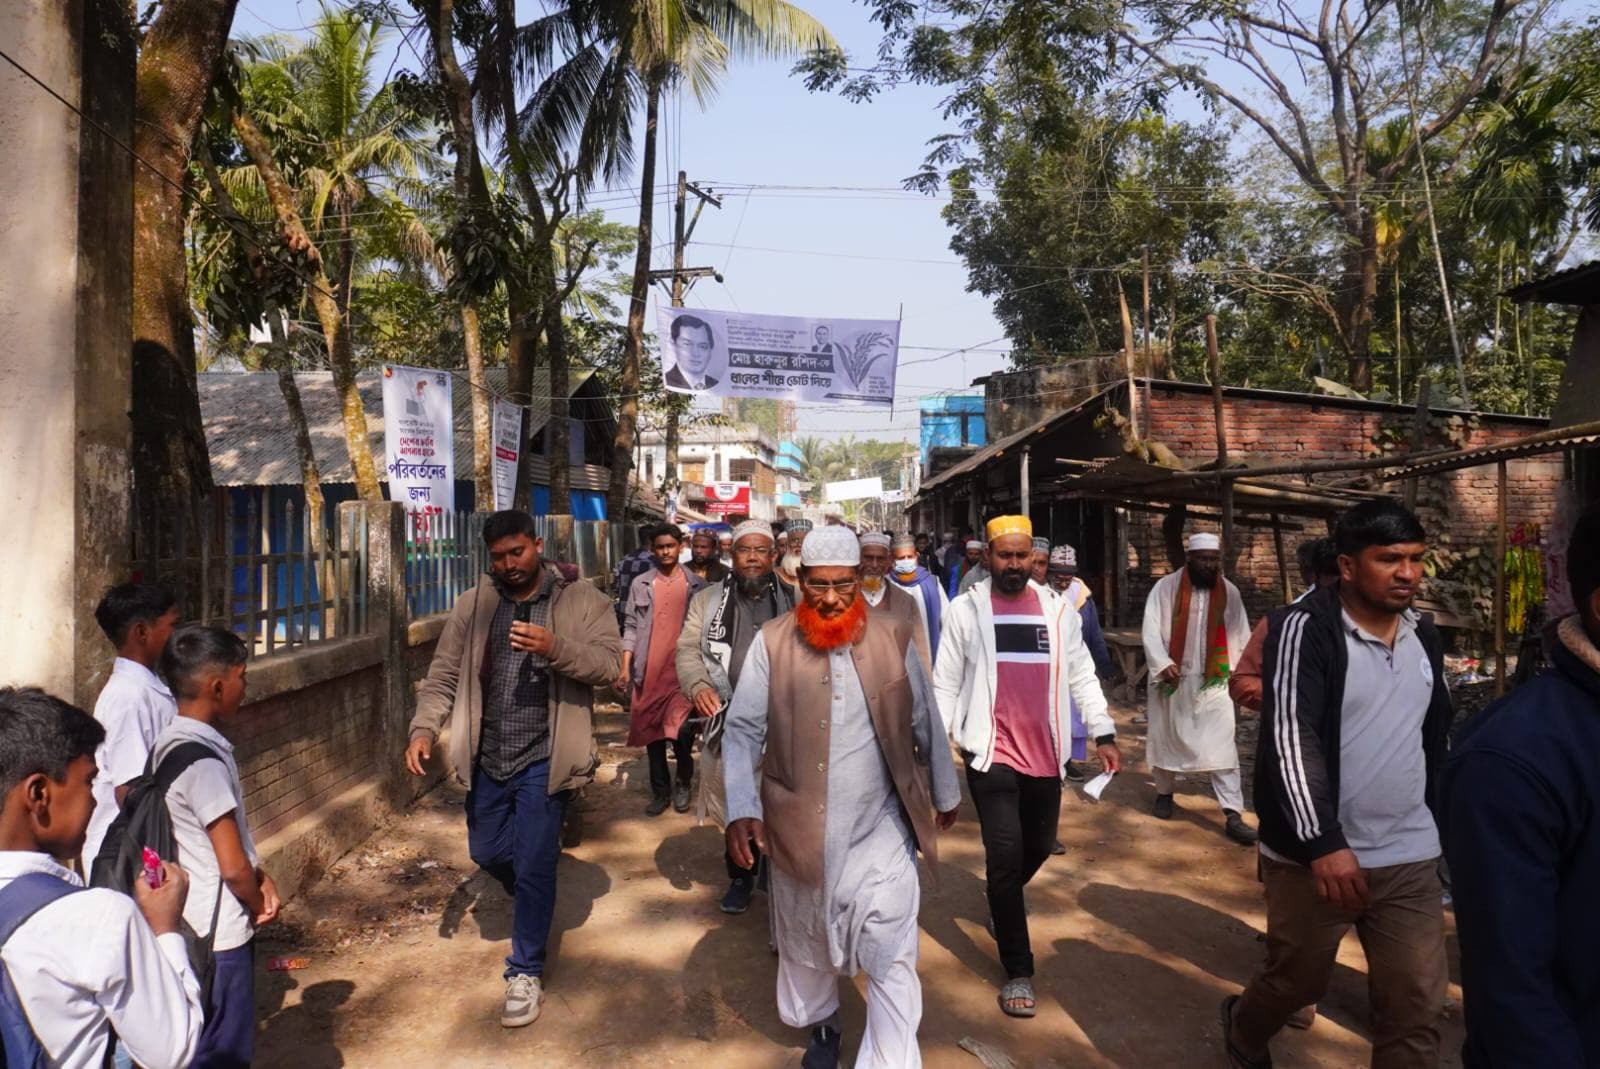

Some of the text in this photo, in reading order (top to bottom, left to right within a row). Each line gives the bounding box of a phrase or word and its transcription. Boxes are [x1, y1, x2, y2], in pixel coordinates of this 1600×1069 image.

[731, 352, 751, 365] মোঃ
[730, 372, 760, 385] ধানের
[762, 370, 785, 386] শীষে
[787, 373, 808, 387] ভোট
[400, 437, 420, 446] দেশের
[400, 447, 421, 456] আপনার
[388, 458, 447, 480] পরিবর্তনের
[407, 486, 431, 502] জন্য
